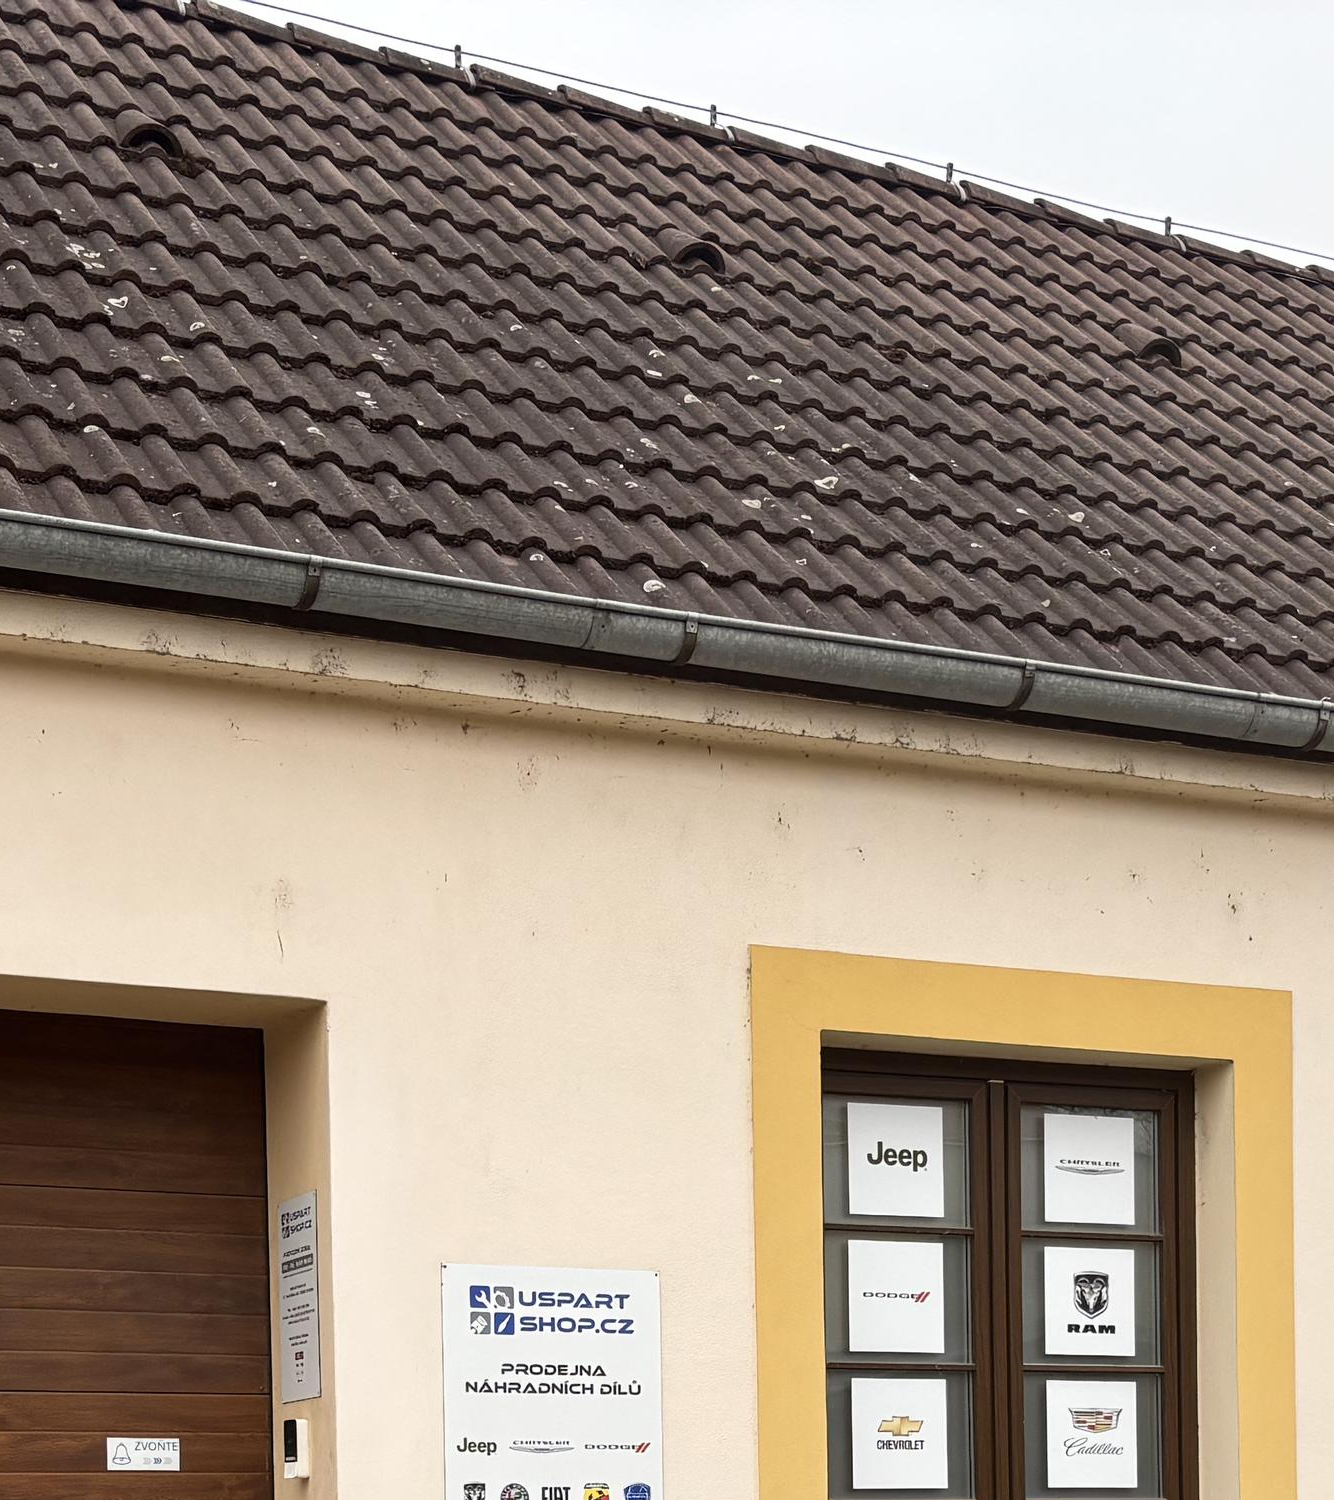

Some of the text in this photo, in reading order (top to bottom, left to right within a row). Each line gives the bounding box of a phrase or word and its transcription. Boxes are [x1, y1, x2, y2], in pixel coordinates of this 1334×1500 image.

[866, 1141, 928, 1172] Jeep
[1059, 1158, 1121, 1167] CHRYSLER
[518, 1290, 630, 1309] USPART
[519, 1316, 635, 1335] SHOP.CZ
[1067, 1323, 1116, 1334] RAM
[500, 1363, 607, 1377] PRODEJNA
[465, 1378, 642, 1396] NÁHRADNÍCH DÍLŮ
[456, 1437, 498, 1456] Jeep
[876, 1439, 925, 1450] CHEVROLET
[1063, 1437, 1124, 1457] Cadillac
